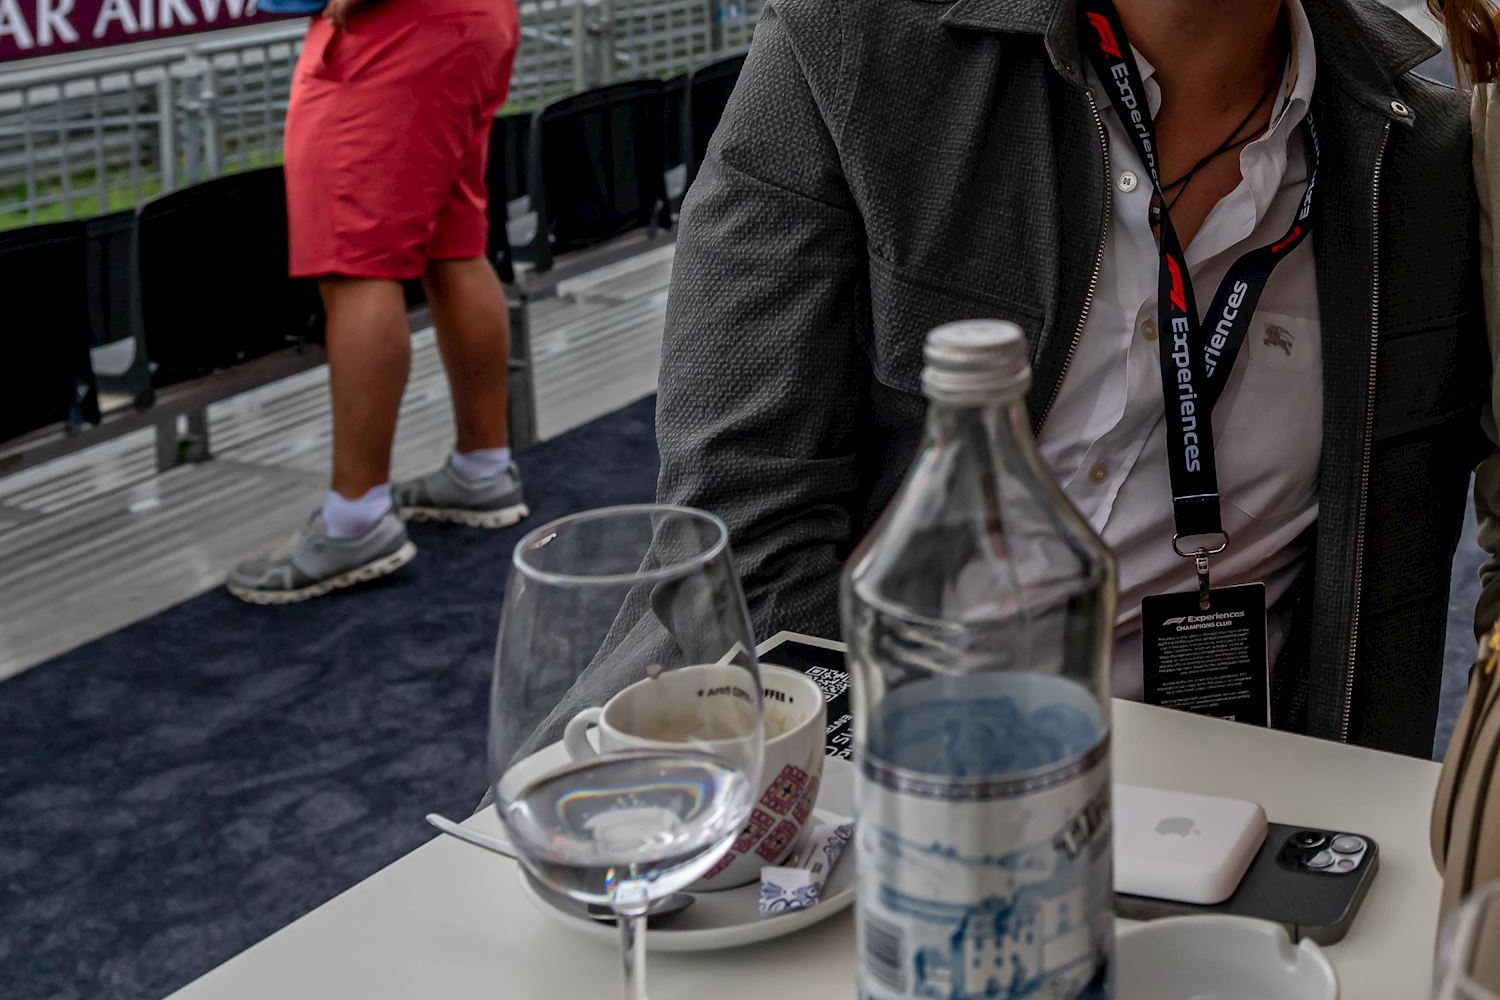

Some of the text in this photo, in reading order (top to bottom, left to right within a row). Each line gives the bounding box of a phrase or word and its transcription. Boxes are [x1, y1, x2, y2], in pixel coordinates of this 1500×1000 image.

[1171, 316, 1201, 473] Experiences
[1187, 610, 1245, 623] Experiences
[1175, 622, 1215, 632] CHAMPIONS
